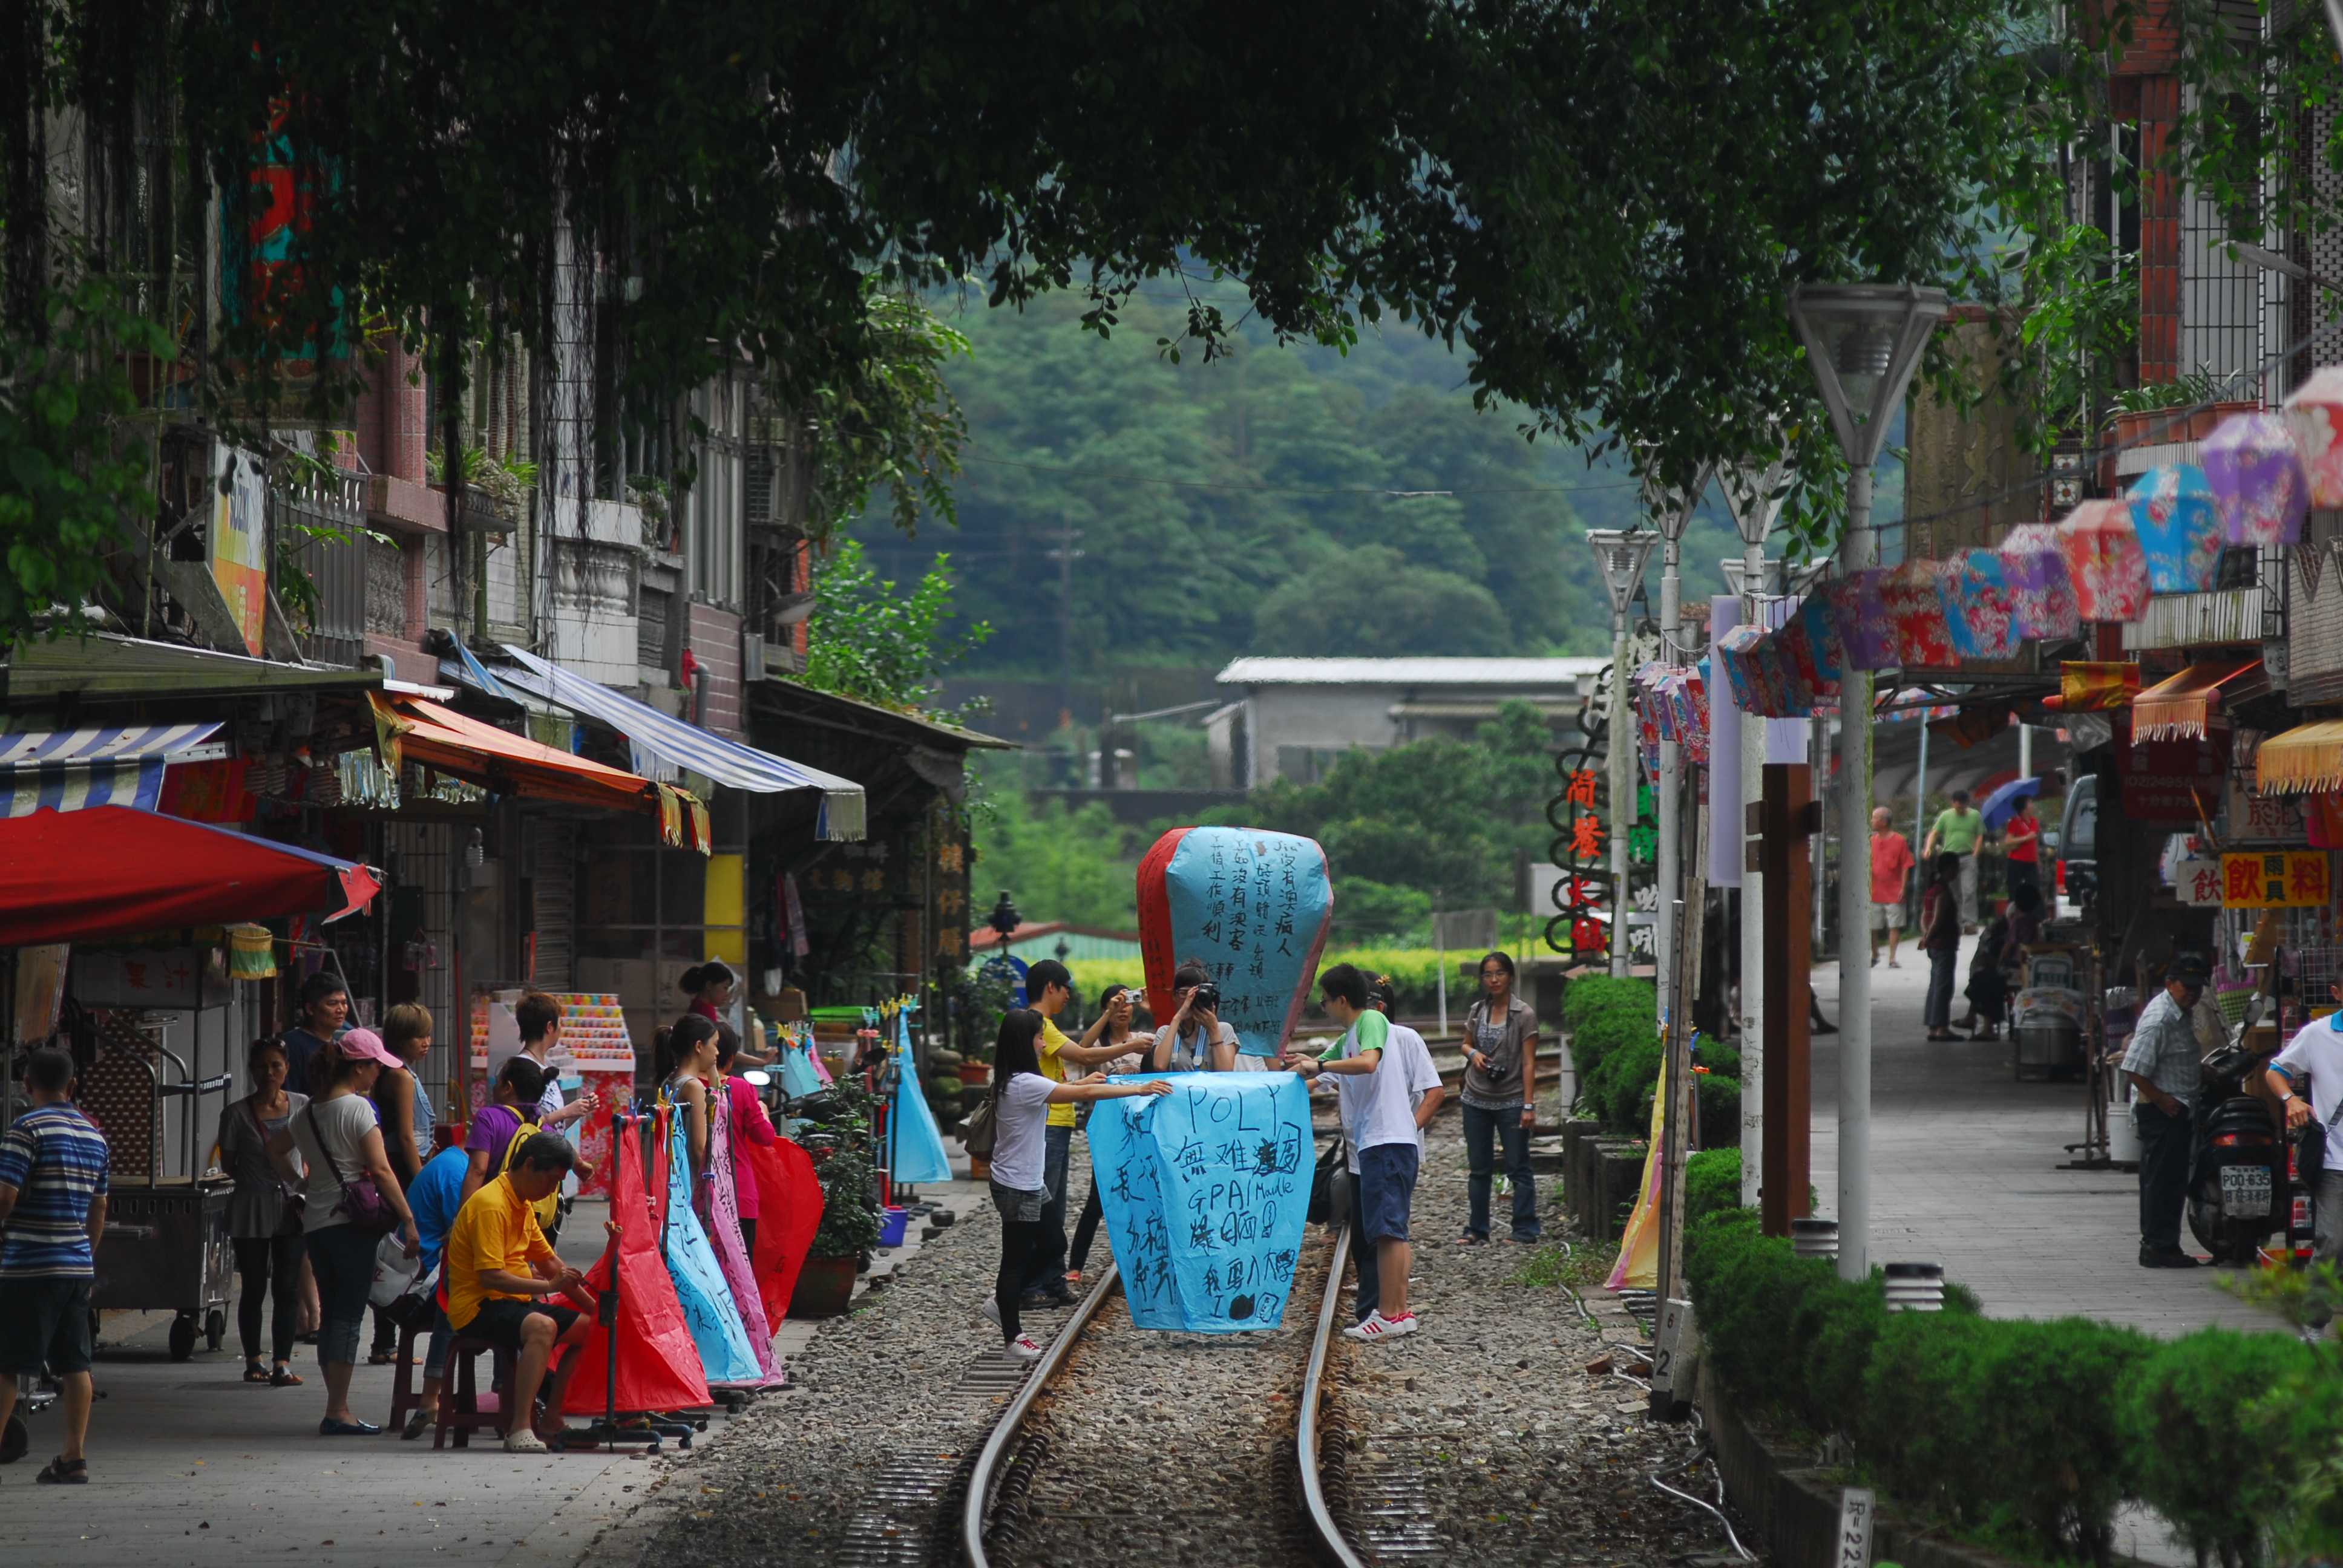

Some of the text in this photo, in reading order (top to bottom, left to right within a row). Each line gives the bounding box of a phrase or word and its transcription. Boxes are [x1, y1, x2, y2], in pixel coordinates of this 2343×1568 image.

[1567, 875, 1607, 953] 火鍋
[1187, 1083, 1281, 1137] POLY
[1656, 1350, 1671, 1377] 2
[1842, 1501, 1866, 1568] R=22
